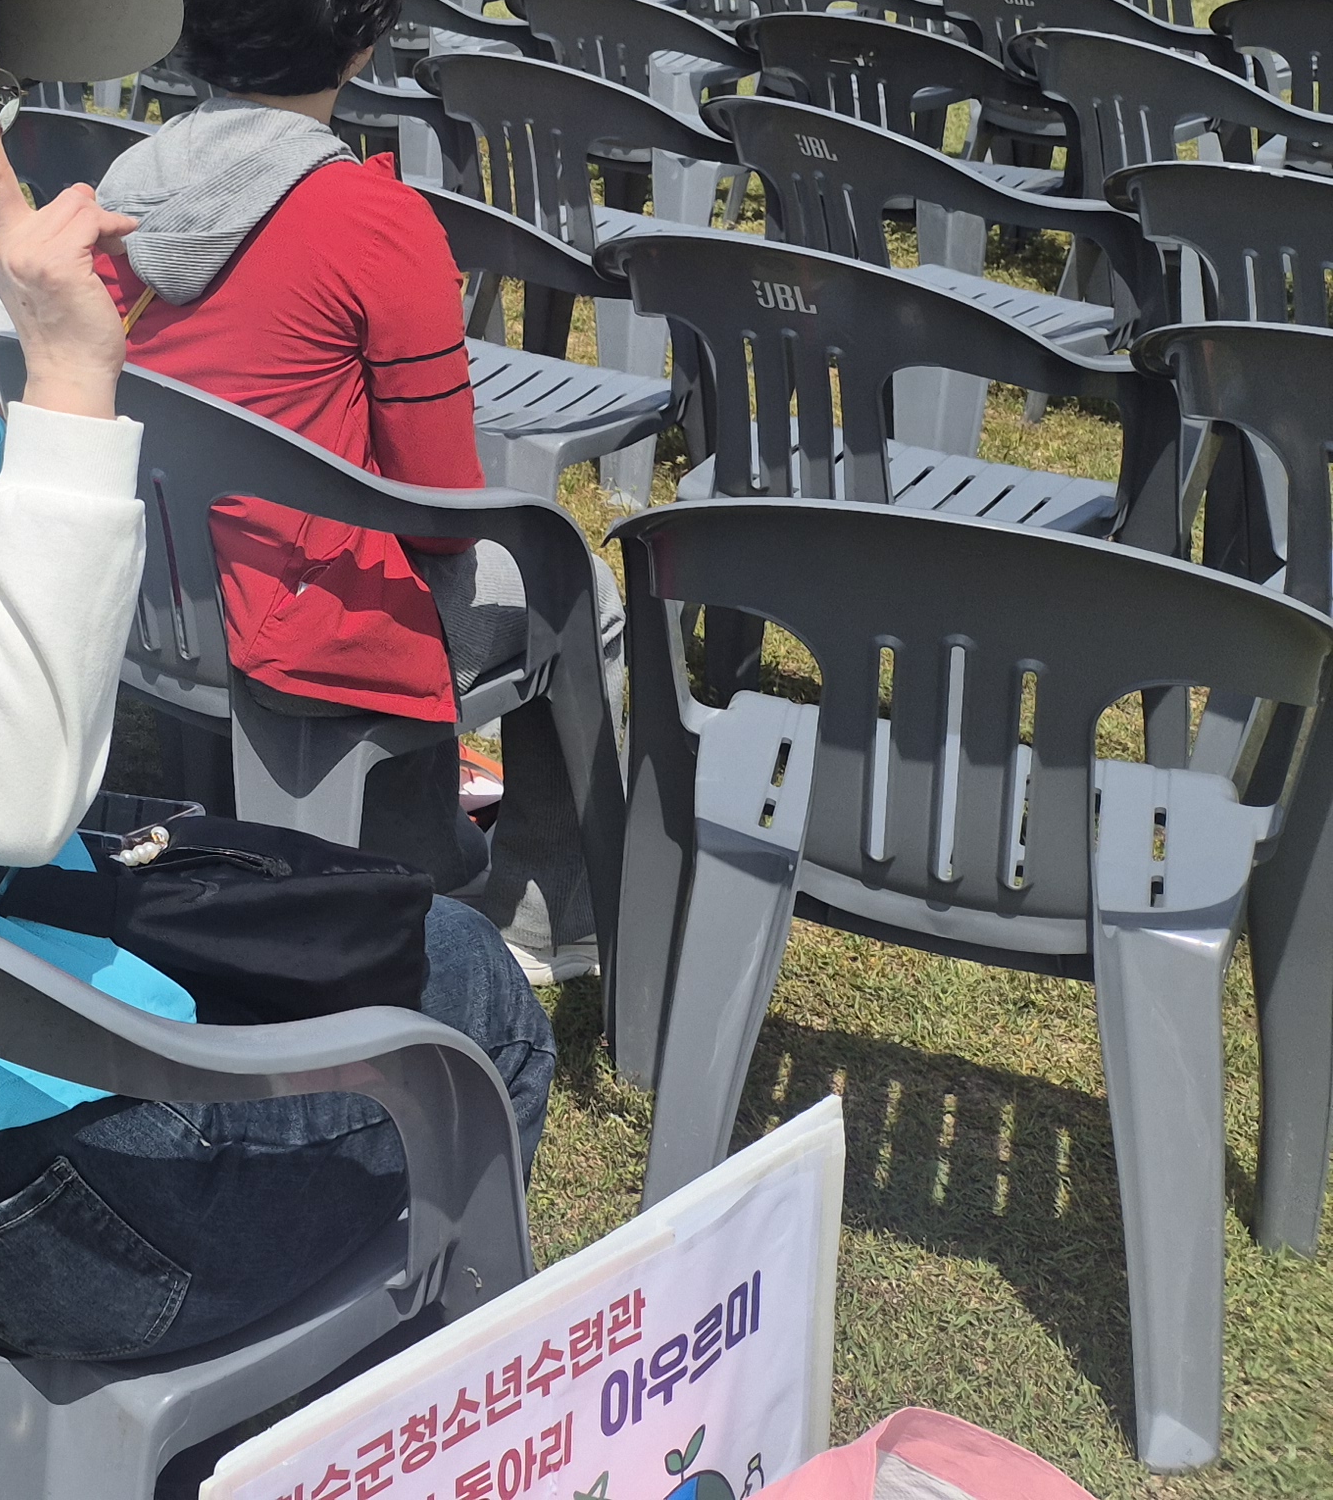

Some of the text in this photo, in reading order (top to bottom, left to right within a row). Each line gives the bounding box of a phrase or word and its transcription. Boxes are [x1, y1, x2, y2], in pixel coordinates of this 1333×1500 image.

[794, 133, 839, 162] JBL
[751, 279, 819, 315] JBL
[276, 1287, 647, 1500] 군청소년수련관
[599, 1269, 763, 1439] 아우르미
